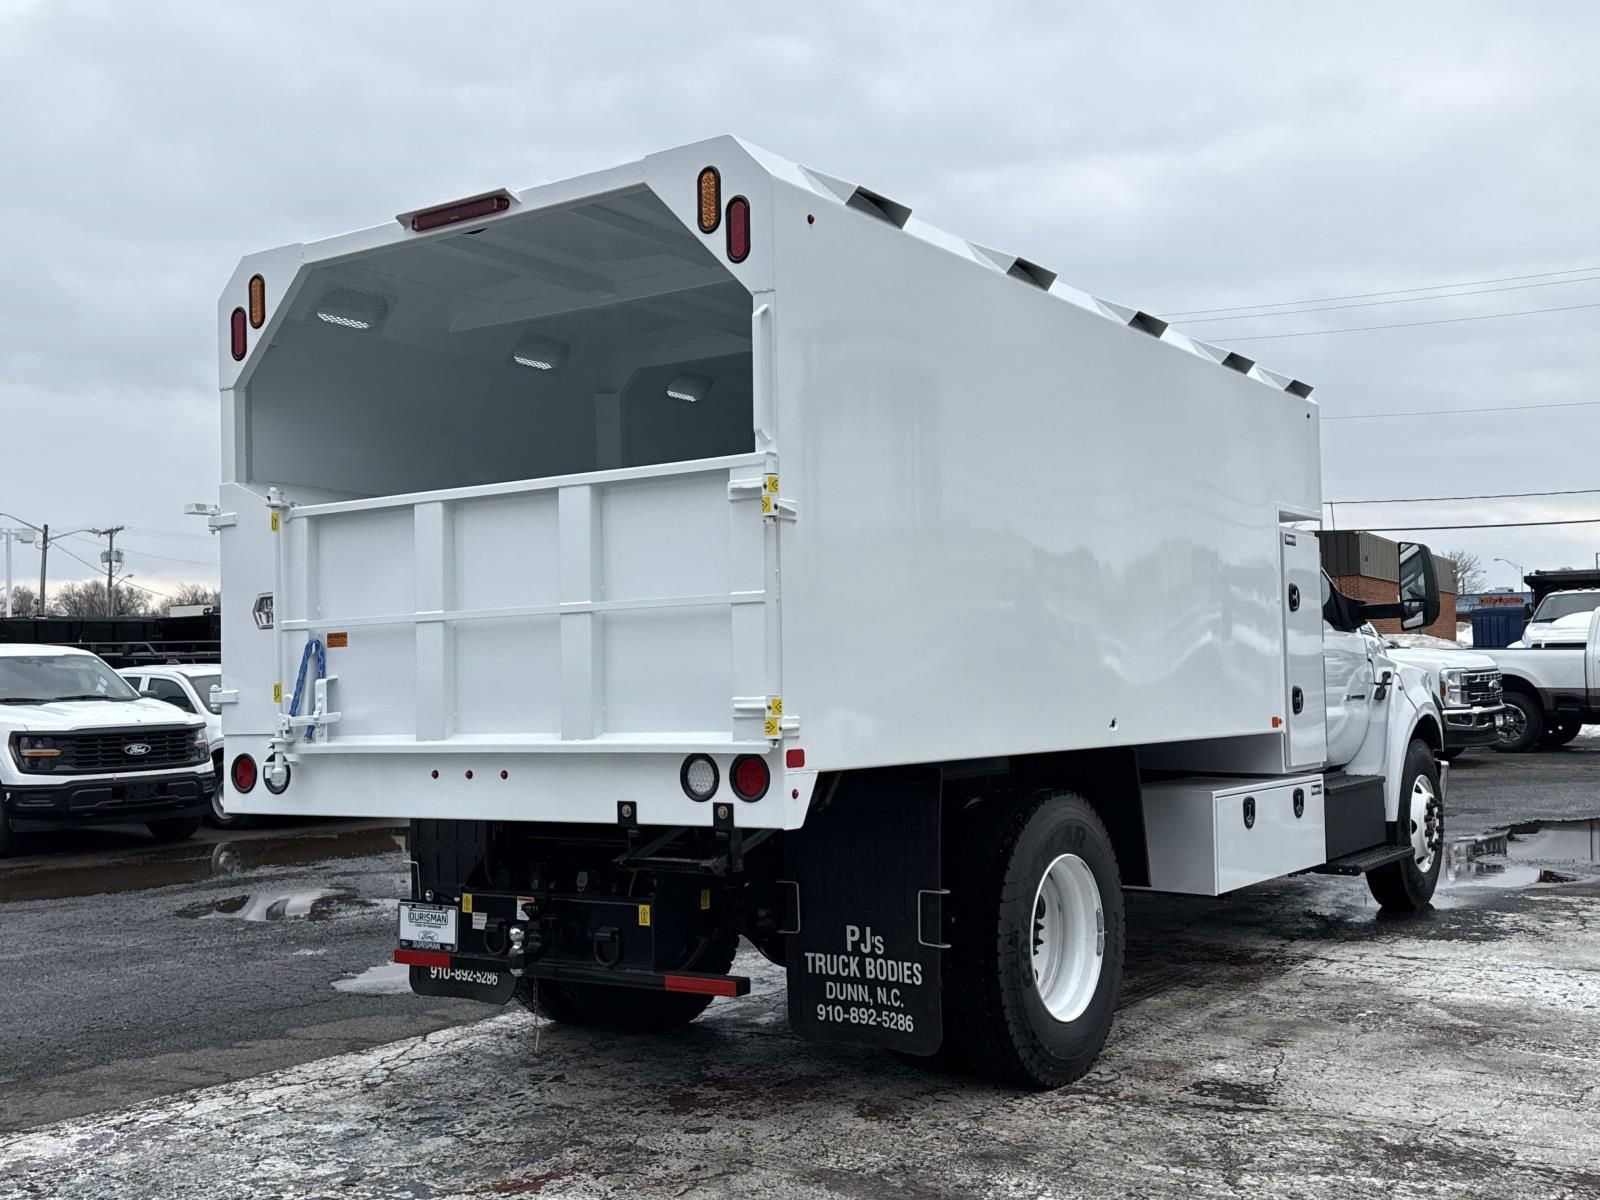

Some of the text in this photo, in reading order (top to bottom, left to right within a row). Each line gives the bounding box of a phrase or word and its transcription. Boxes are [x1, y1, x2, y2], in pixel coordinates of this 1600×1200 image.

[409, 911, 447, 923] OURISMAN
[804, 952, 922, 985] TRUCK BODIES
[826, 981, 904, 1008] DUNN, N.C.
[817, 1004, 914, 1032] 910-892-5286
